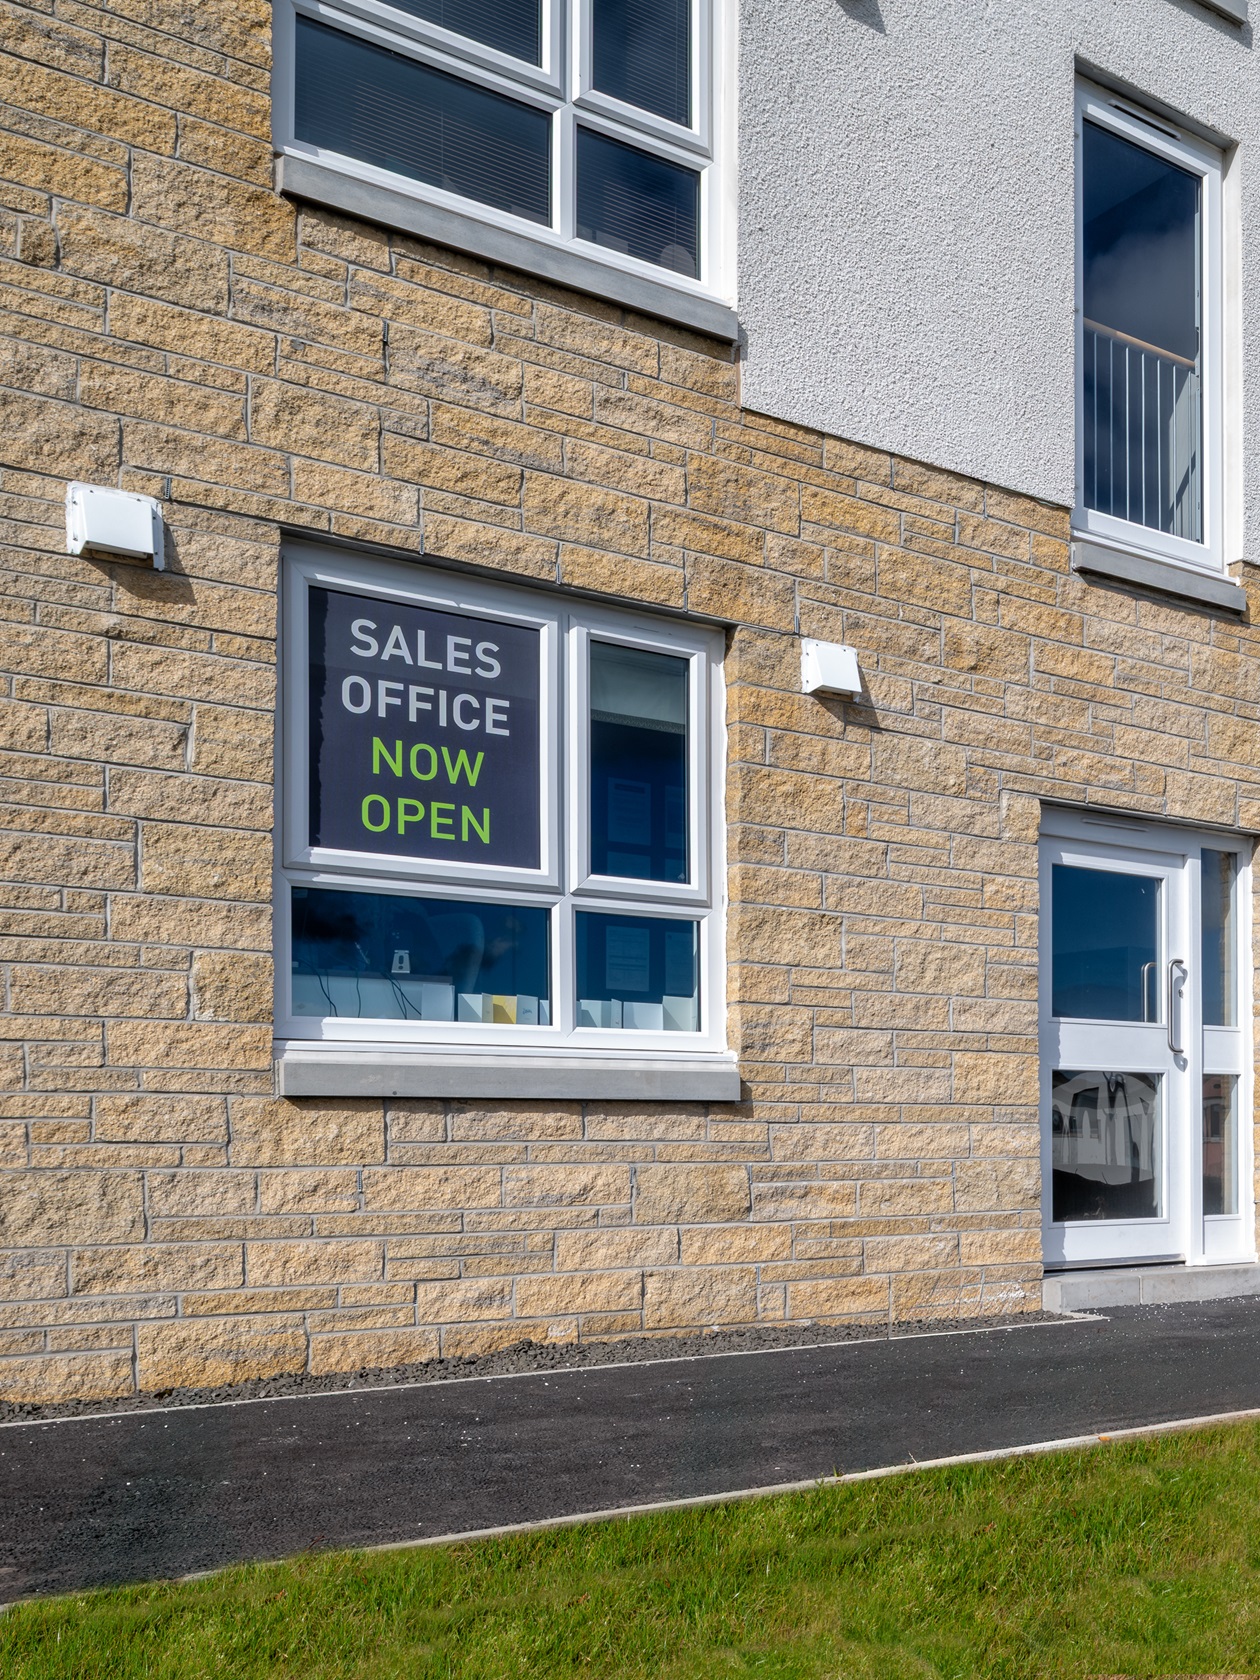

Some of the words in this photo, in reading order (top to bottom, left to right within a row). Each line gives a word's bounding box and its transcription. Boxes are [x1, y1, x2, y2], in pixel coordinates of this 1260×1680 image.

[349, 618, 502, 679] SALES
[341, 675, 510, 736] OFFICE
[372, 736, 484, 787] NOW
[361, 794, 490, 844] OPEN
